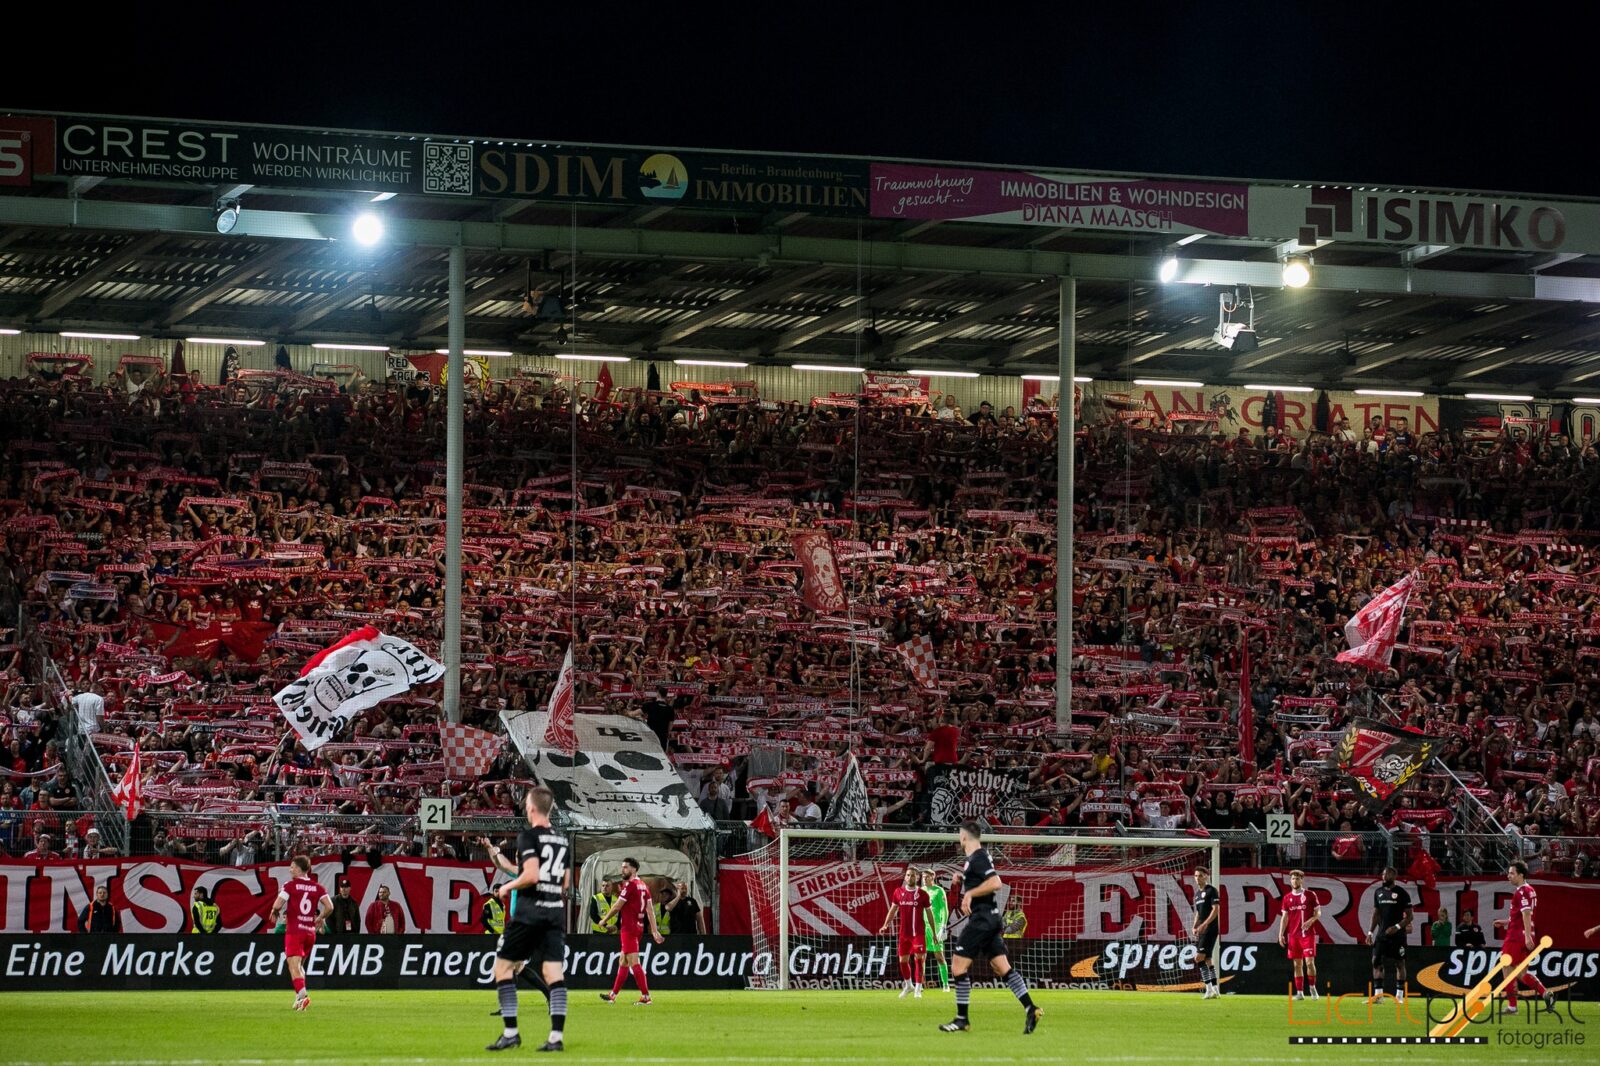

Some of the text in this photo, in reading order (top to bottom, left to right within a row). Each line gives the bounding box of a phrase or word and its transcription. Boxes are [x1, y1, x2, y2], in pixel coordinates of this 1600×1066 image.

[63, 125, 239, 163] CREST
[252, 142, 412, 169] WOHNTRÄUME
[62, 158, 239, 180] UNTERNEHMENSGRUPPE
[252, 163, 412, 185] WERDEN WIRKLICHKEIT
[479, 150, 627, 199] SDIM
[721, 163, 756, 176] Berlin
[767, 166, 843, 181] Brandenburg
[696, 179, 867, 208] IMMOBILIEN
[875, 176, 973, 194] Traumwohnung
[1001, 180, 1245, 210] IMMOBILIEN & WOHNDESIGN
[1022, 203, 1173, 230] DIANA MAASCH
[1367, 197, 1566, 250] ISIMKO
[388, 357, 408, 368] RED
[949, 769, 1014, 793] Freiheit
[427, 804, 446, 825] 21
[1269, 819, 1292, 839] 22
[539, 844, 568, 884] 24
[797, 863, 864, 898] ENERGIE
[299, 891, 312, 915] 6
[846, 890, 880, 911] COTTBUS
[6, 942, 84, 976] Eine
[101, 942, 213, 976] Marke
[306, 943, 383, 976] EMB
[789, 944, 890, 977] GmbH
